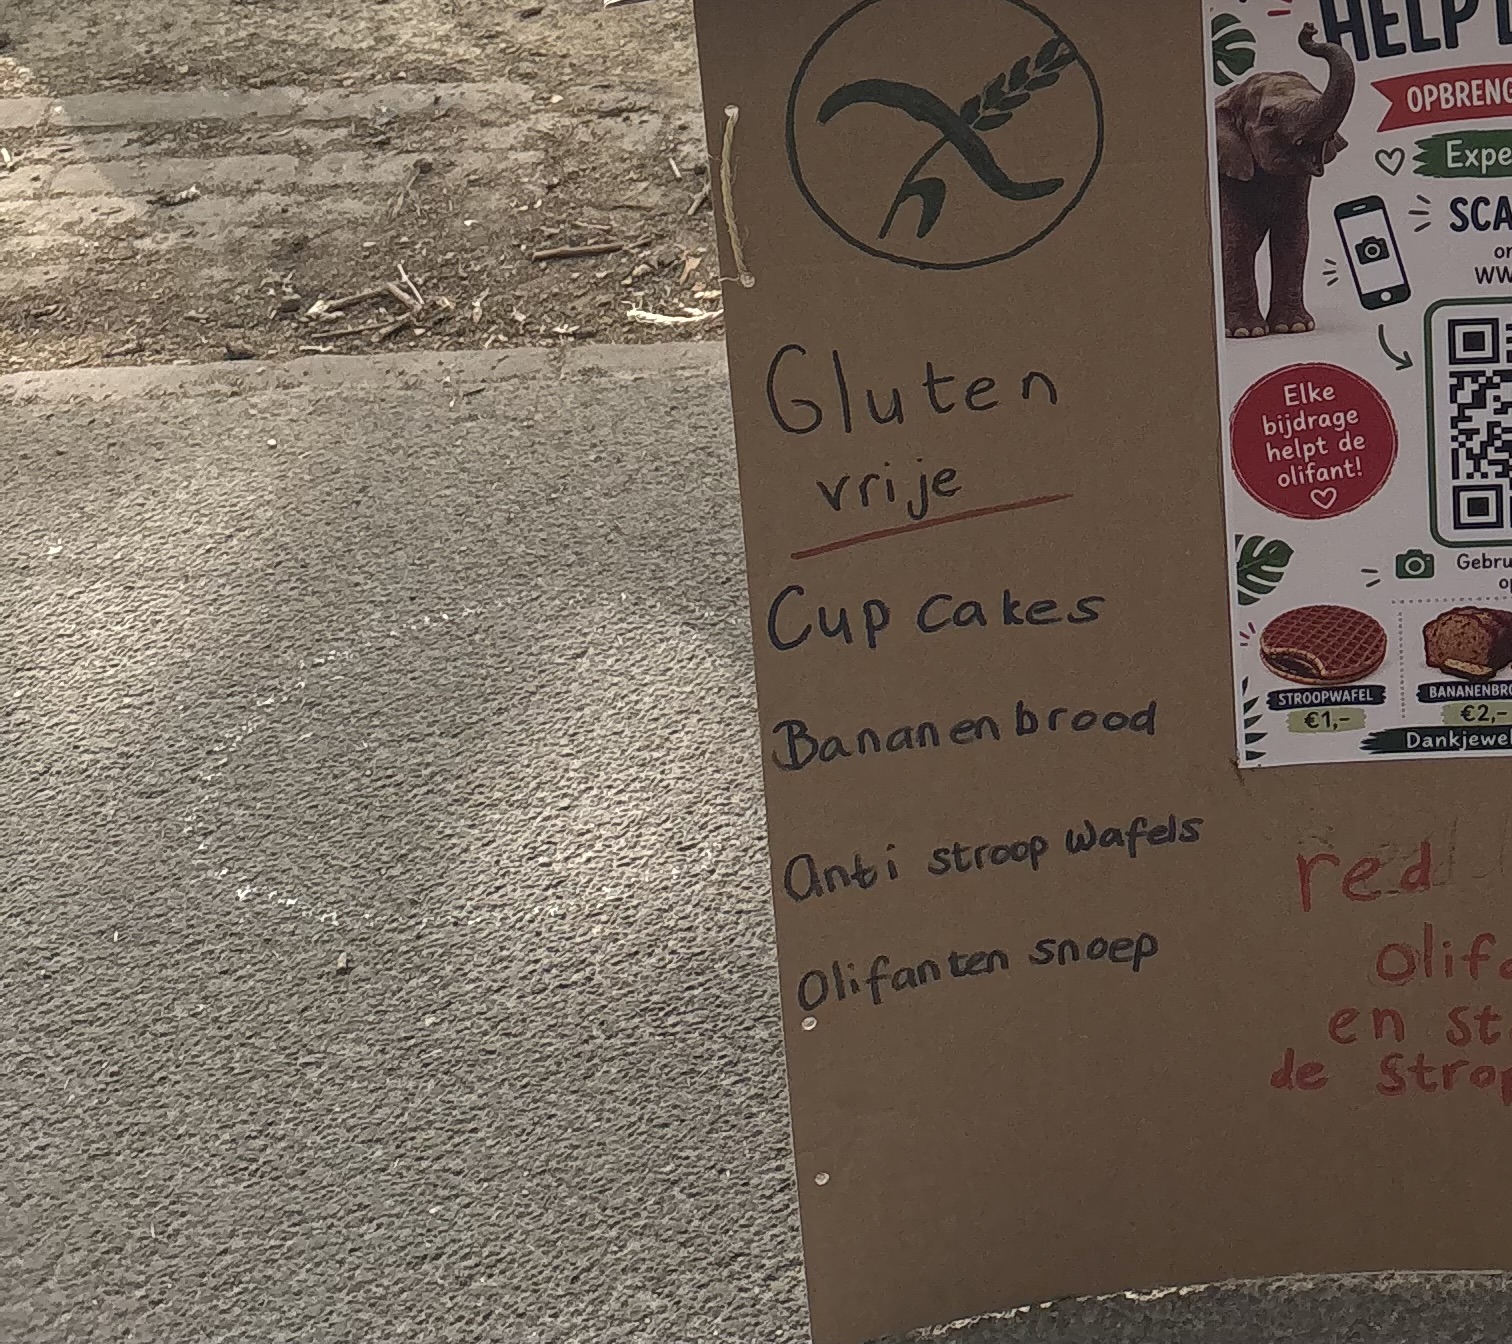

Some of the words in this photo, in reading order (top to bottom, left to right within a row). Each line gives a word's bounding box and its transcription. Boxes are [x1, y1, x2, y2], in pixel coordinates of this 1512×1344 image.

[766, 343, 1059, 435] Gluten
[1284, 382, 1336, 409] Elke
[1262, 406, 1360, 442] bijdrage
[1265, 435, 1332, 465] helpt
[1337, 430, 1366, 453] de
[816, 458, 963, 521] vrije
[1277, 455, 1363, 489] olifant!
[1278, 687, 1374, 706] STROOPWAFEL
[1296, 841, 1433, 912] red
[798, 946, 1009, 1012] Olifanten
[1030, 929, 1159, 972] snoep
[1328, 1006, 1406, 1045] en
[1269, 1048, 1330, 1091] de
